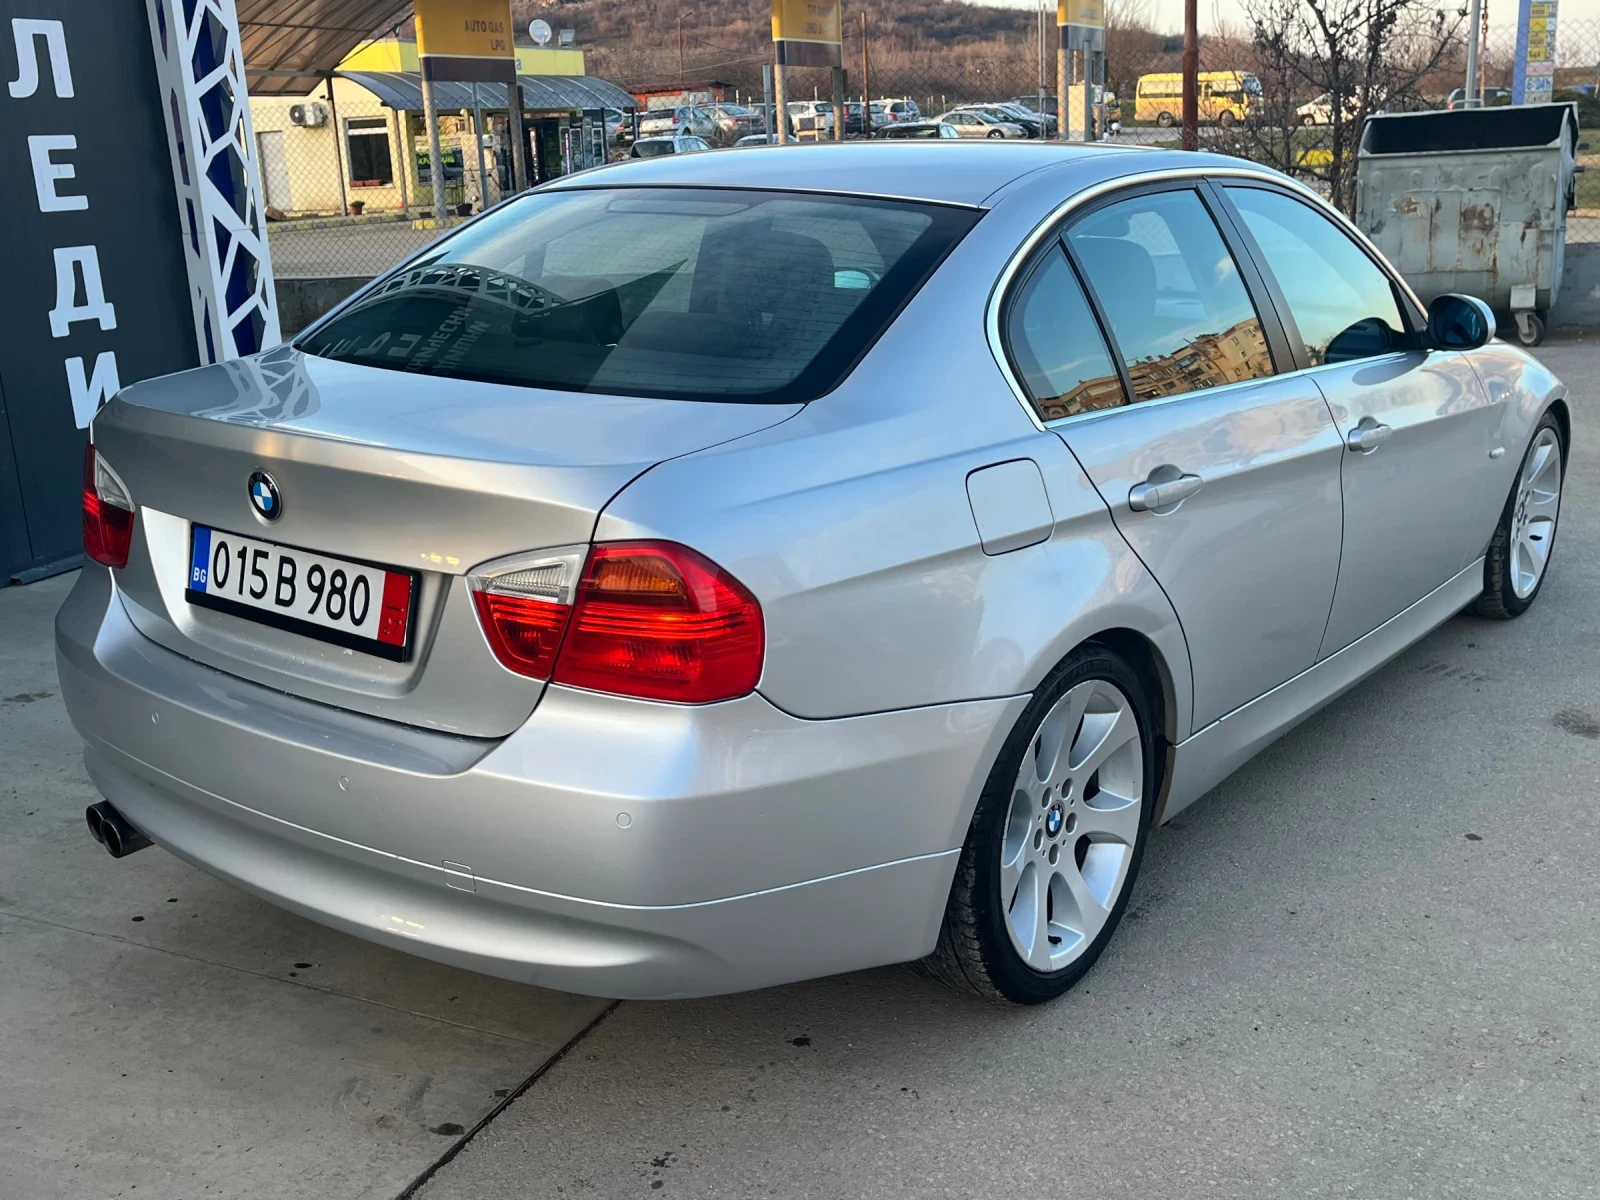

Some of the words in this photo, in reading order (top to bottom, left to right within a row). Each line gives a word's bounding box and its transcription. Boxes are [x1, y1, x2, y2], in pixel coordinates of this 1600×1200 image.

[464, 19, 487, 33] AUTO
[488, 20, 505, 34] GAS
[490, 38, 506, 51] LPG
[193, 566, 207, 583] BG
